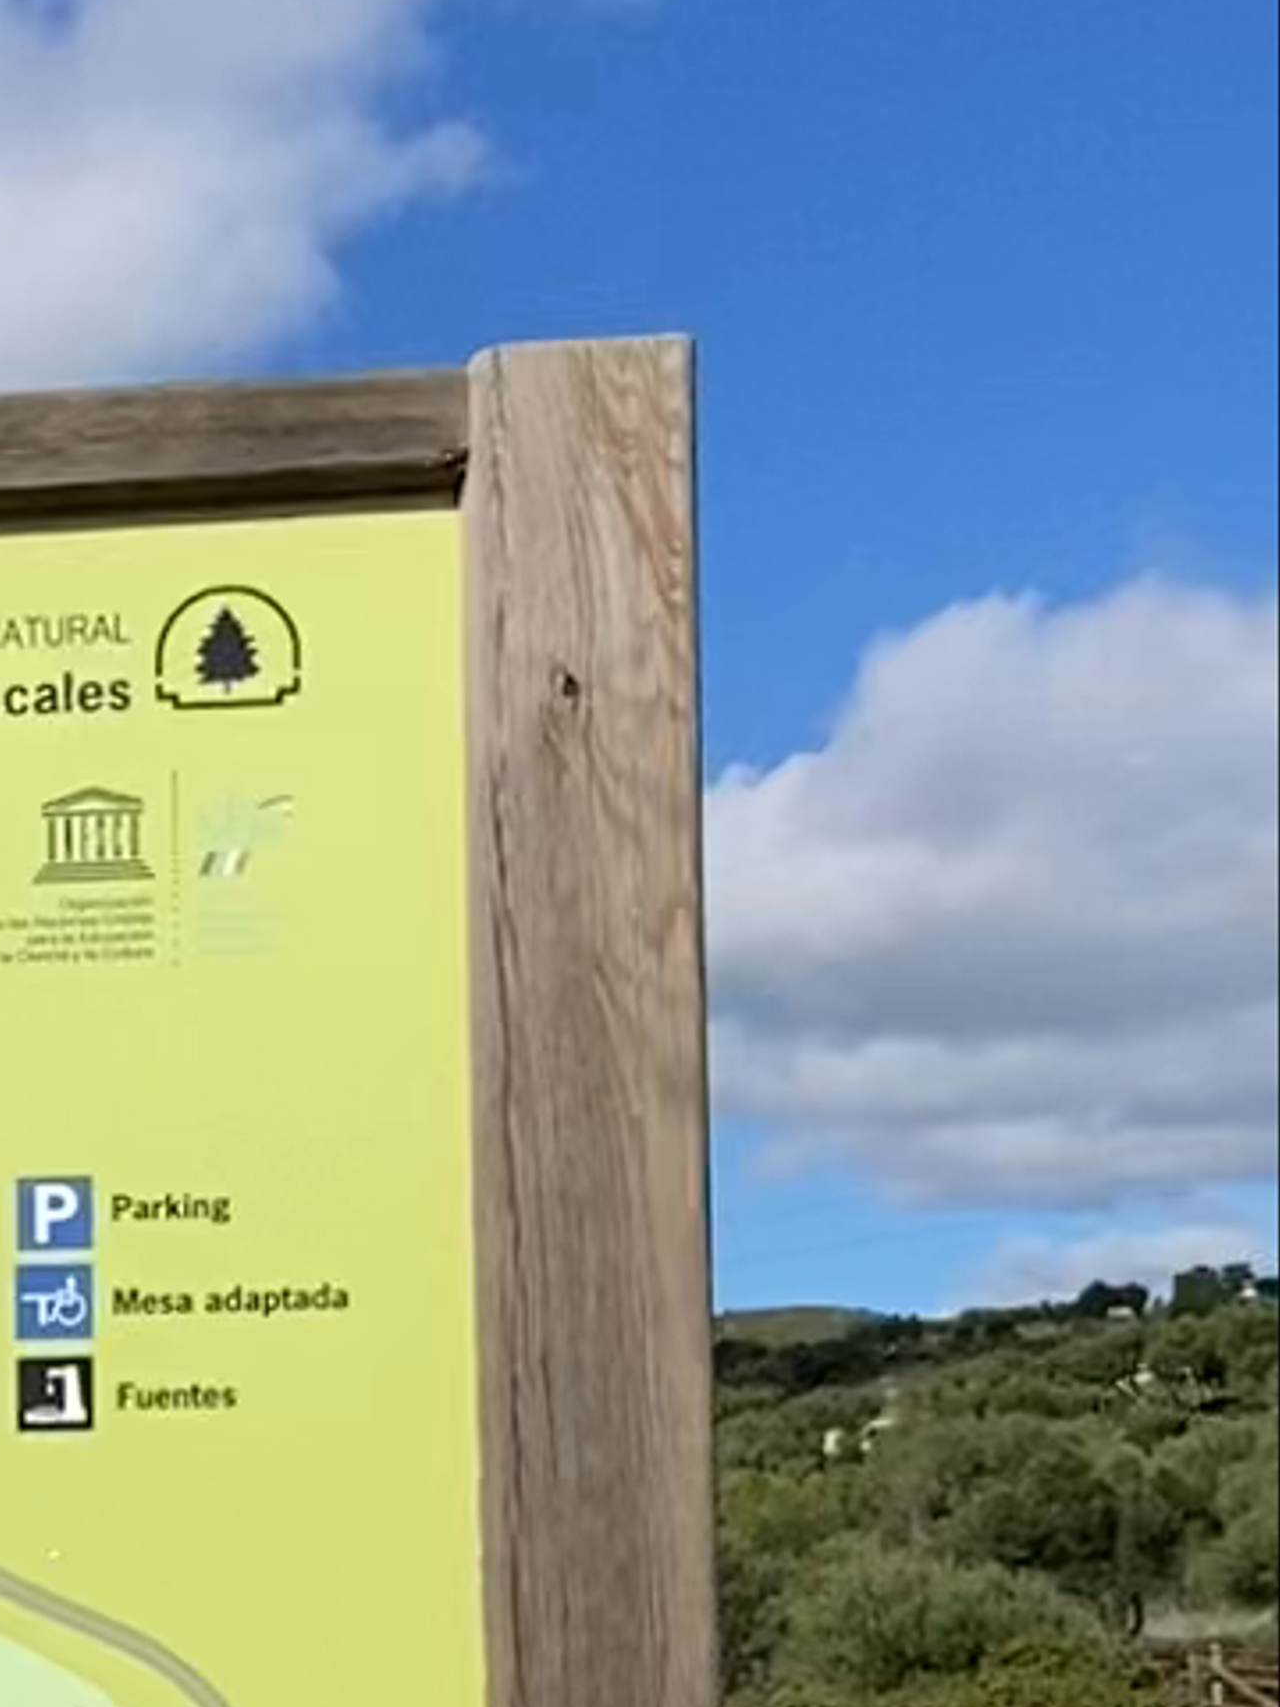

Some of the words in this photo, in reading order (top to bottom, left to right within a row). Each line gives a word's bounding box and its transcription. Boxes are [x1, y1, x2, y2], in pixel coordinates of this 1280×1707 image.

[111, 1192, 231, 1223] Parking
[112, 1288, 193, 1315] Mesa
[204, 1283, 349, 1317] adaptada
[116, 1382, 237, 1410] Fuentes
